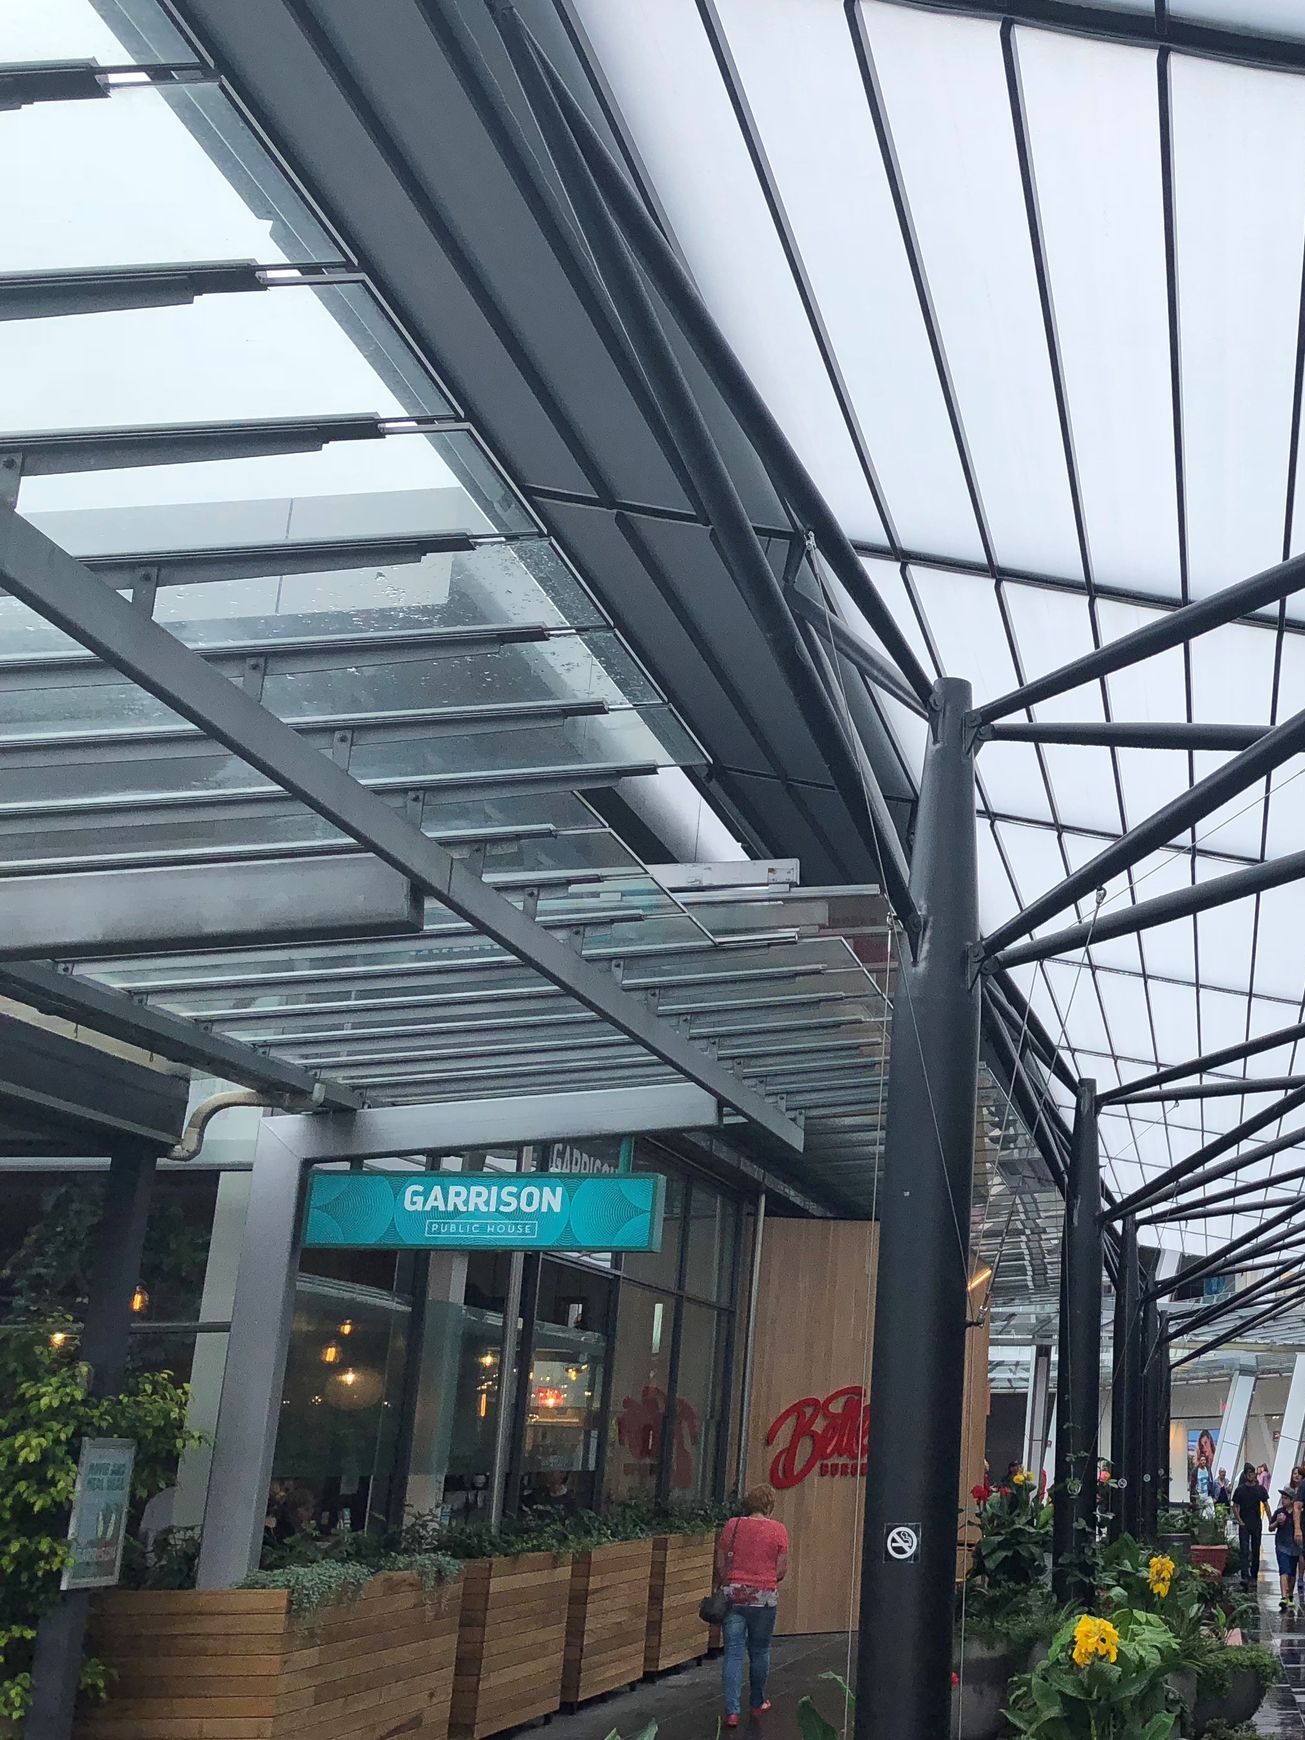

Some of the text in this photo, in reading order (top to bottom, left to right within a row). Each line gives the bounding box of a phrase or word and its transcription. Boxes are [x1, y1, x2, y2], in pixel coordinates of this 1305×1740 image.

[552, 1143, 617, 1173] GARRI
[403, 1184, 563, 1213] GARRISON
[431, 1223, 531, 1233] PUBLIC HOUSE
